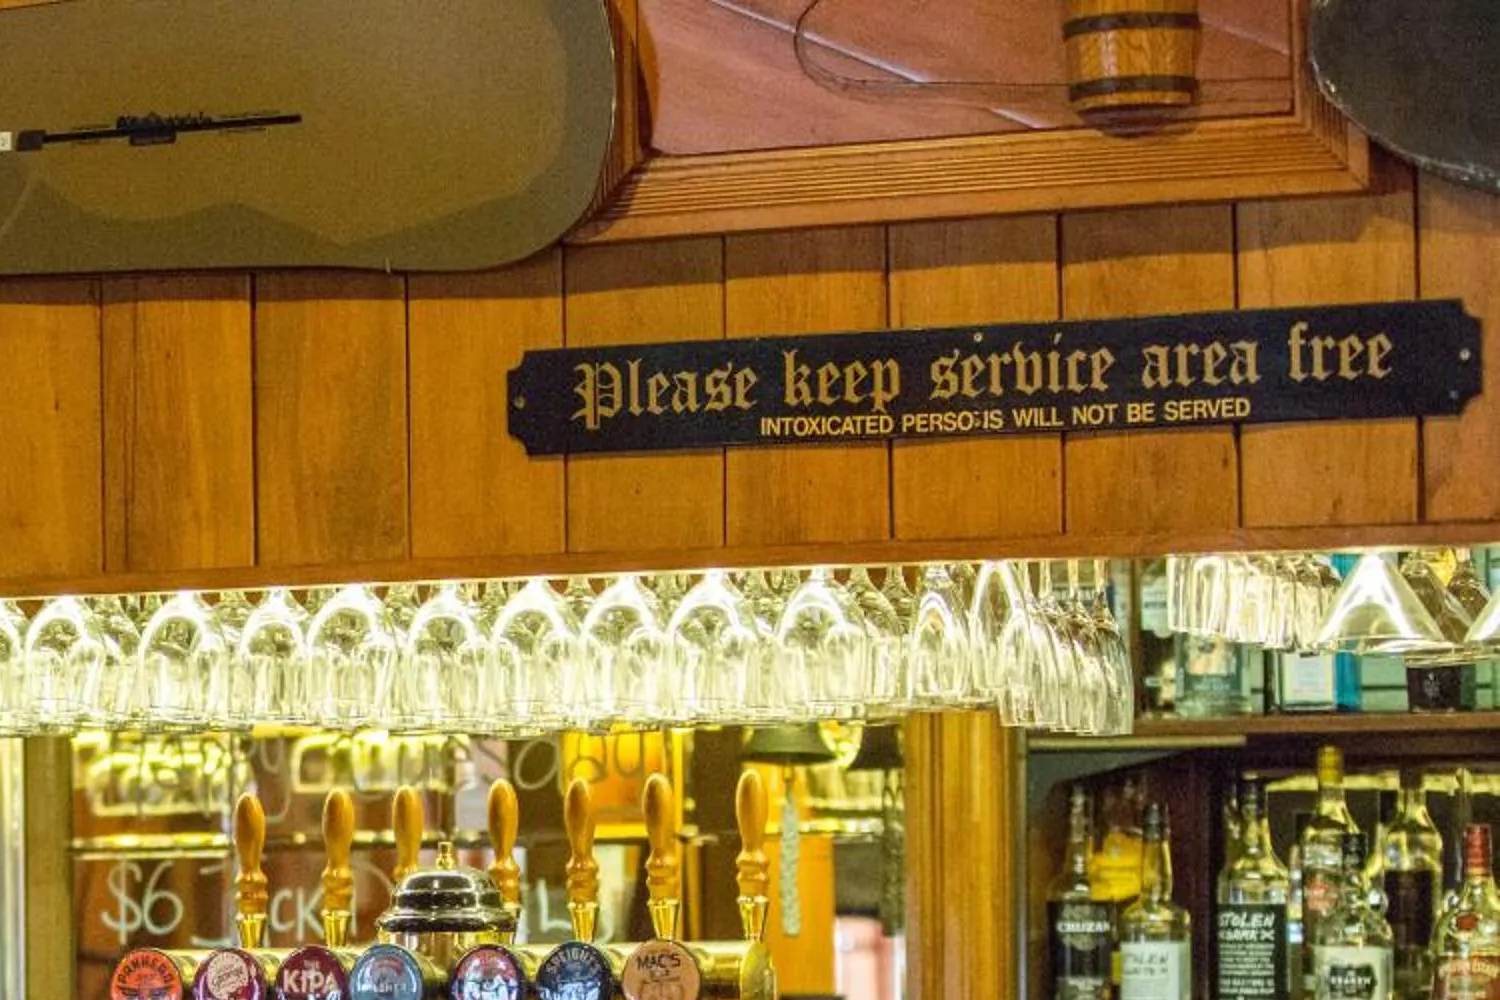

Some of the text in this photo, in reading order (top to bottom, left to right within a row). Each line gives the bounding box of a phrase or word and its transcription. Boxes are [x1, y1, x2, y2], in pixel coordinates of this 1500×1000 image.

[570, 320, 1393, 430] Please keep service area free
[760, 414, 893, 436] INTOXICATED
[1012, 406, 1064, 428] WILL
[1072, 403, 1118, 425] NOT
[1126, 402, 1156, 423] BE
[1163, 397, 1252, 422] SERVED
[101, 858, 184, 946] $6
